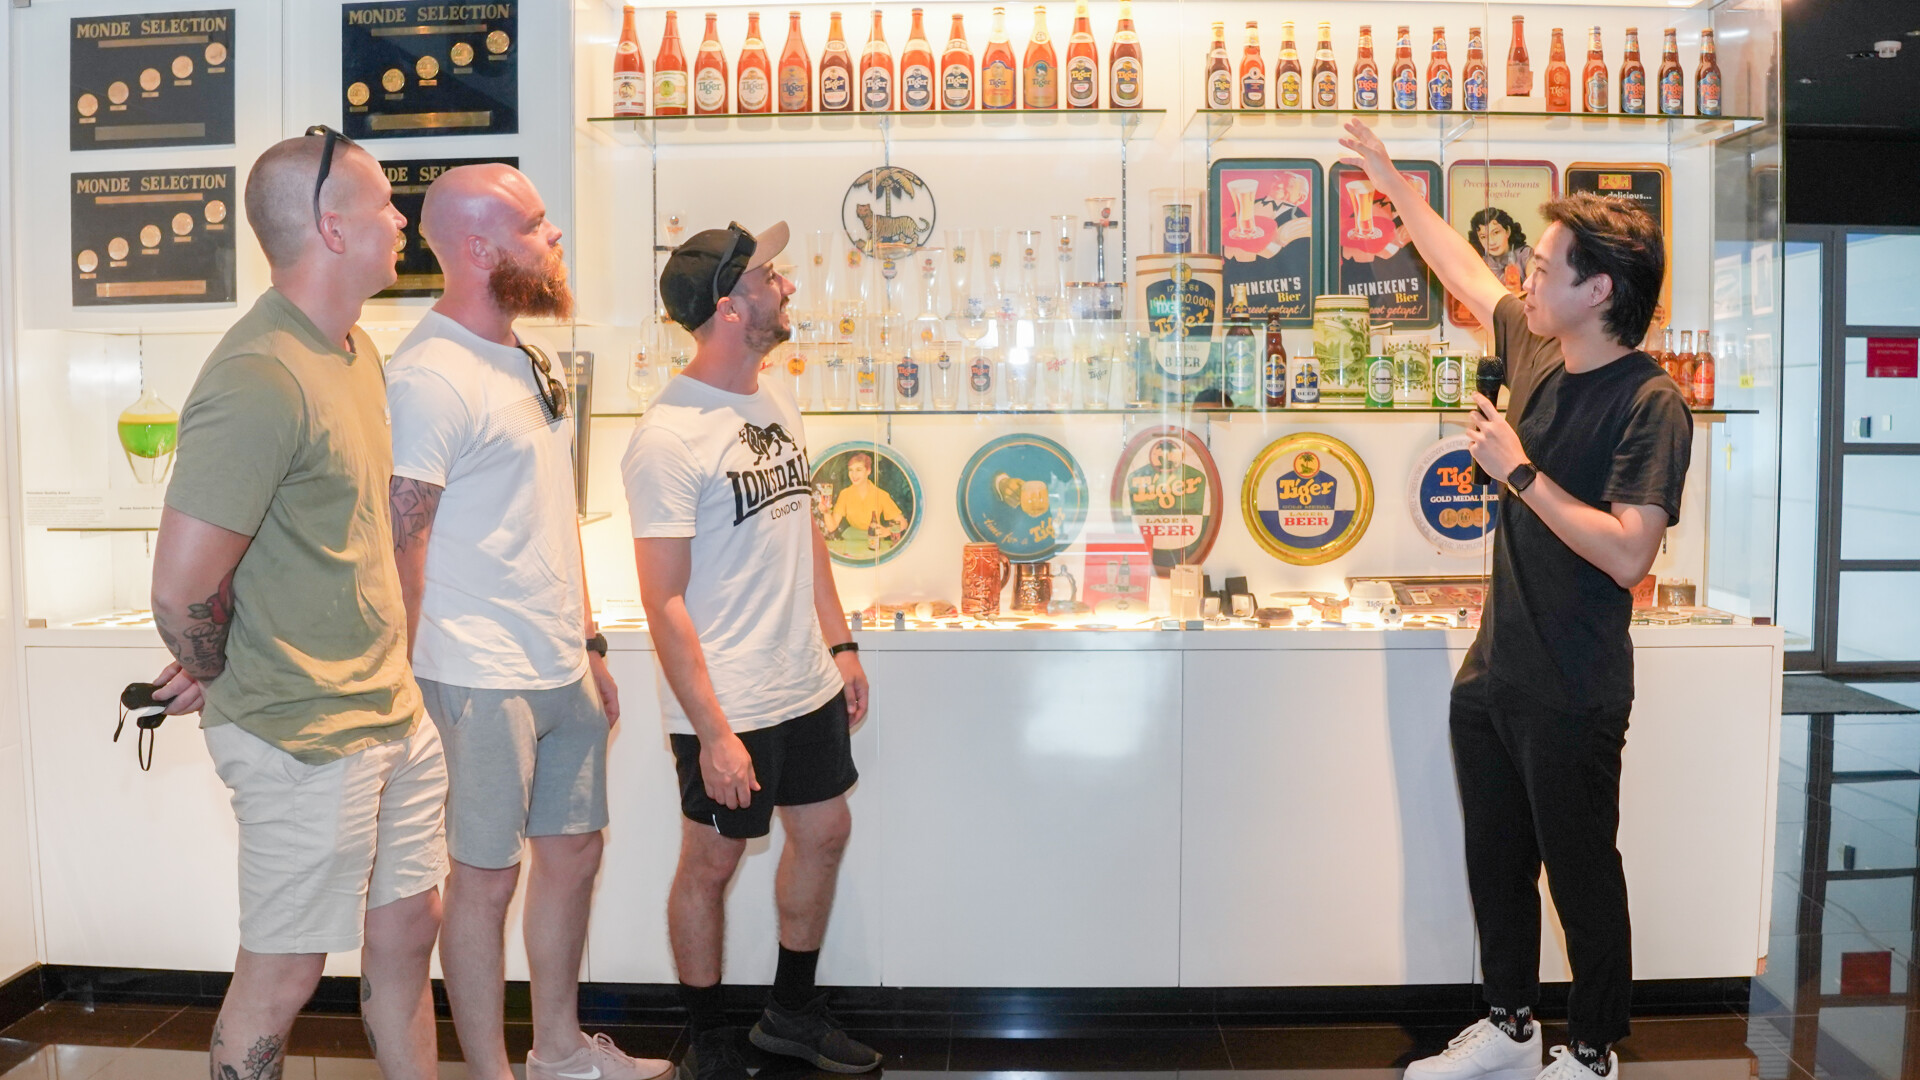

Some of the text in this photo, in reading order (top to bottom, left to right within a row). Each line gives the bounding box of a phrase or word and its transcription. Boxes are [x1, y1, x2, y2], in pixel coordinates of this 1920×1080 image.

[348, 4, 511, 25] MONDE SELECTION
[76, 16, 228, 39] MONDE SELECTION
[697, 81, 721, 95] Tiger
[741, 81, 764, 95] Tiger
[782, 82, 805, 97] Tiger
[1357, 80, 1378, 92] Tiger
[76, 173, 228, 194] MONDE SELECTION
[1463, 178, 1541, 190] Precious Moments
[1486, 190, 1521, 202] Together
[1348, 277, 1420, 297] HEINEKEN'S
[1277, 291, 1302, 304] Bier
[1395, 292, 1419, 304] Bier
[1154, 308, 1209, 339] Tiger
[1165, 357, 1201, 368] BEER
[897, 366, 918, 377] Tiger
[1088, 368, 1109, 381] Tiger
[1131, 472, 1203, 510] Tiger
[1279, 478, 1335, 506] Tiger
[1430, 496, 1452, 504] GOLD
[1453, 495, 1480, 503] MEDAL
[771, 500, 802, 520] LONDON
[1284, 517, 1329, 526] BEER
[1138, 525, 1197, 537] BEER
